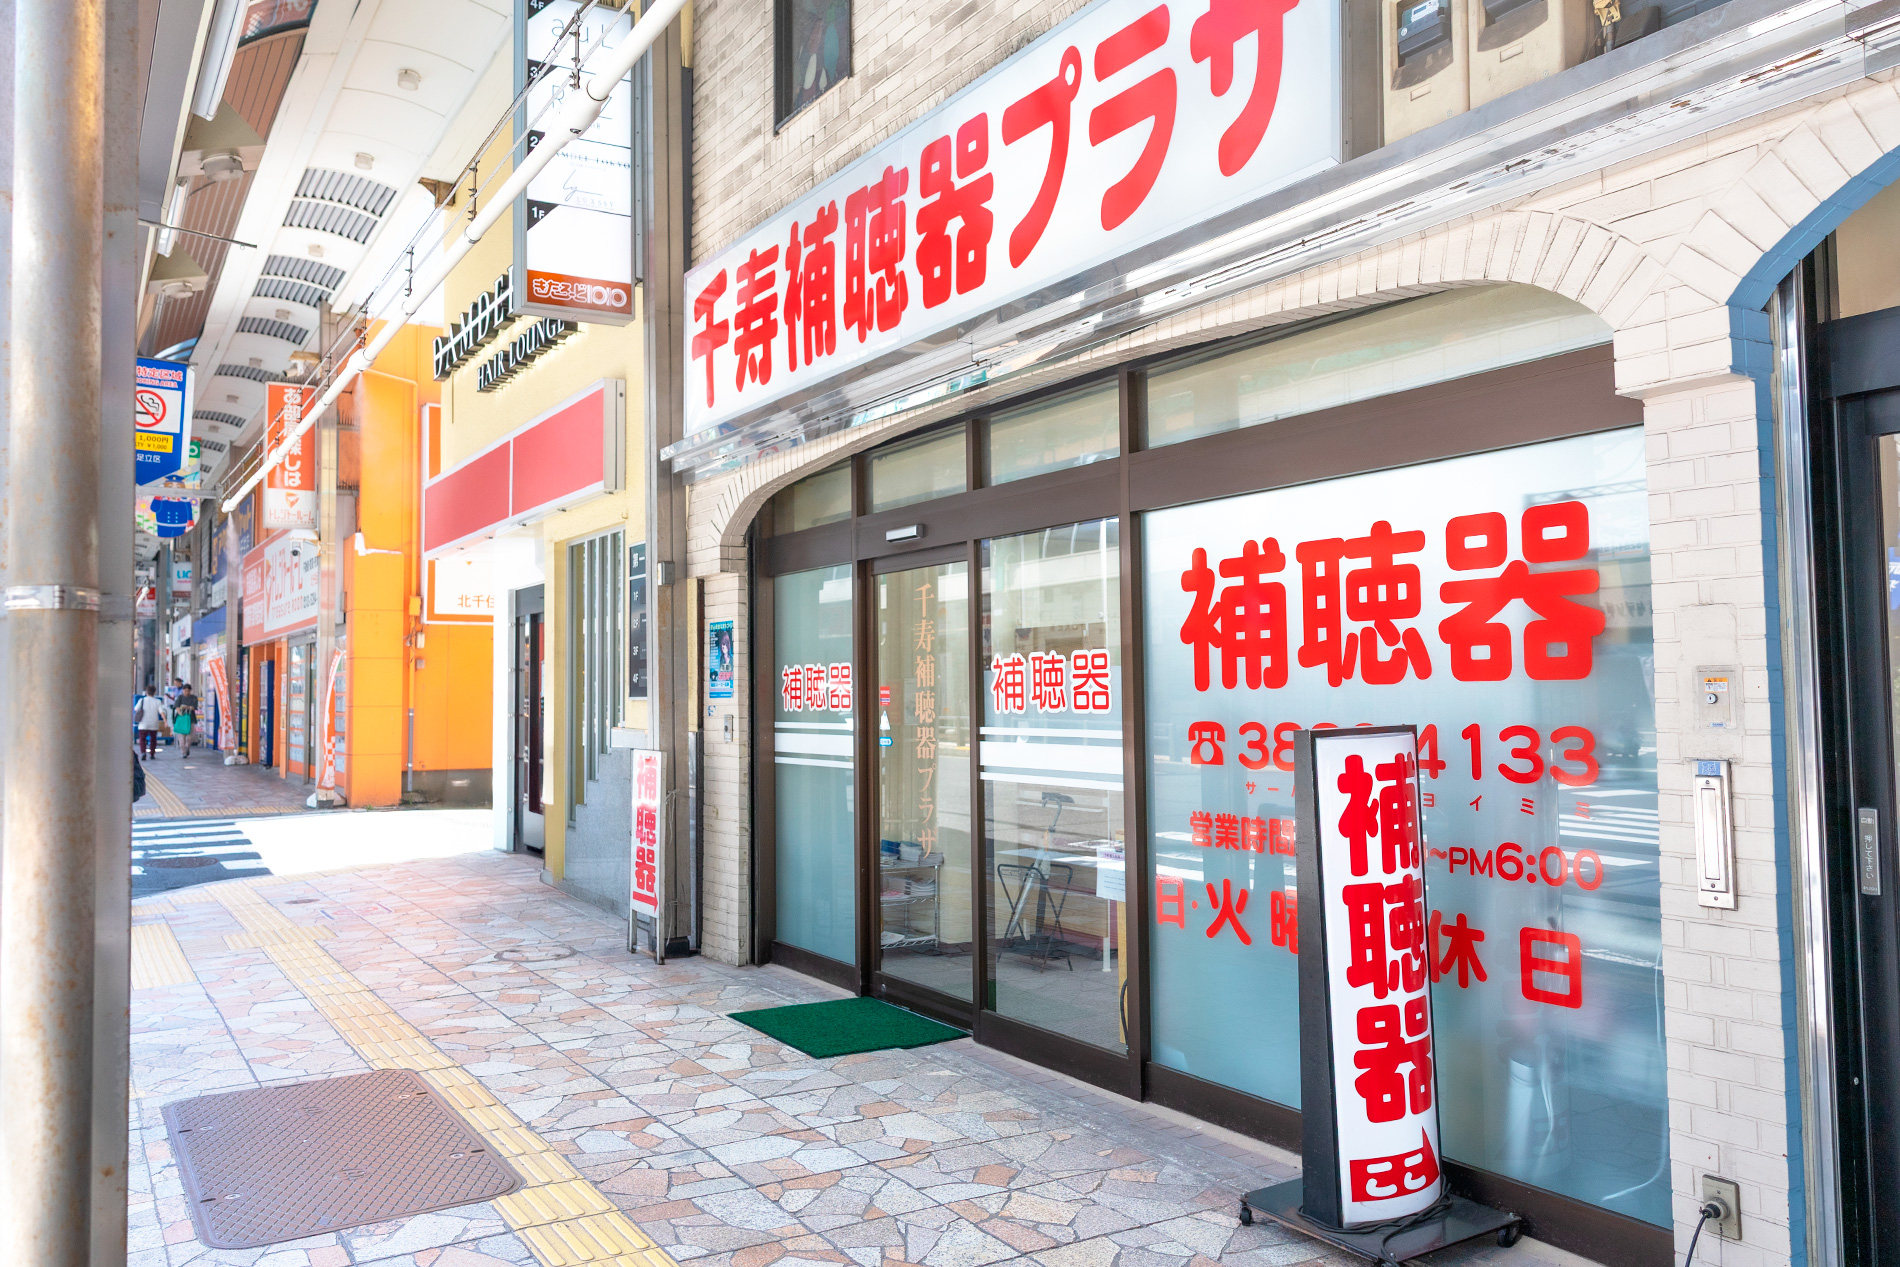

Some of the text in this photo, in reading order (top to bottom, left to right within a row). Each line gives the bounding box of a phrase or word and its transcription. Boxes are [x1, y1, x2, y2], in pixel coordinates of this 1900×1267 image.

[531, 206, 545, 219] 1F
[137, 366, 183, 381] 特定区域
[477, 317, 565, 392] HAIR LOUNGE
[160, 380, 178, 389] AREA
[136, 453, 161, 463] 足立区
[1179, 501, 1606, 691] 補聴器
[781, 662, 853, 712] 補聴器
[991, 650, 1112, 714] 補聴器
[914, 582, 938, 859] 千寿補聴器プラザ
[636, 754, 658, 893] 補聴器
[1190, 810, 1296, 857] 営業時間
[1338, 751, 1433, 1124] 補聴器
